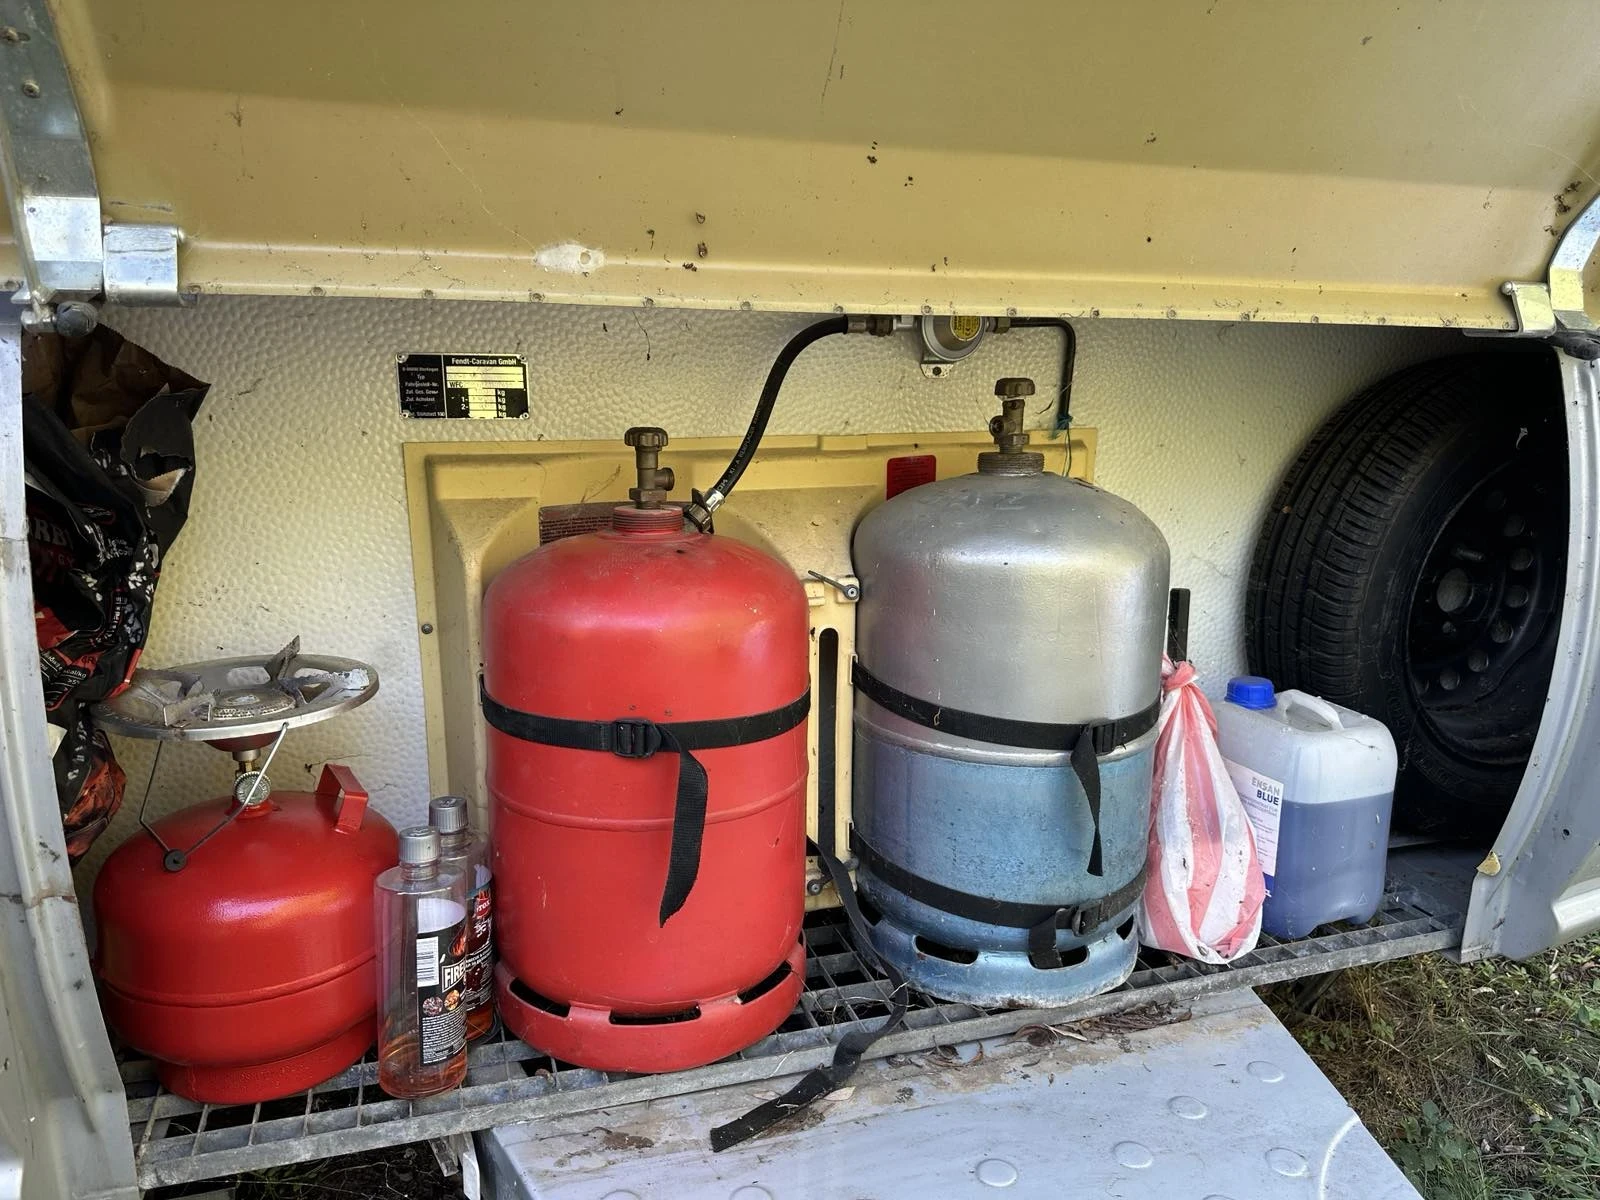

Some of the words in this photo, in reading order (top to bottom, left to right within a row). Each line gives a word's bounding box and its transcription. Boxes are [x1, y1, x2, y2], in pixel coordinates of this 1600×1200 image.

[449, 380, 464, 388] WFC
[1251, 776, 1280, 797] ENSAN
[1256, 788, 1280, 806] BLUE
